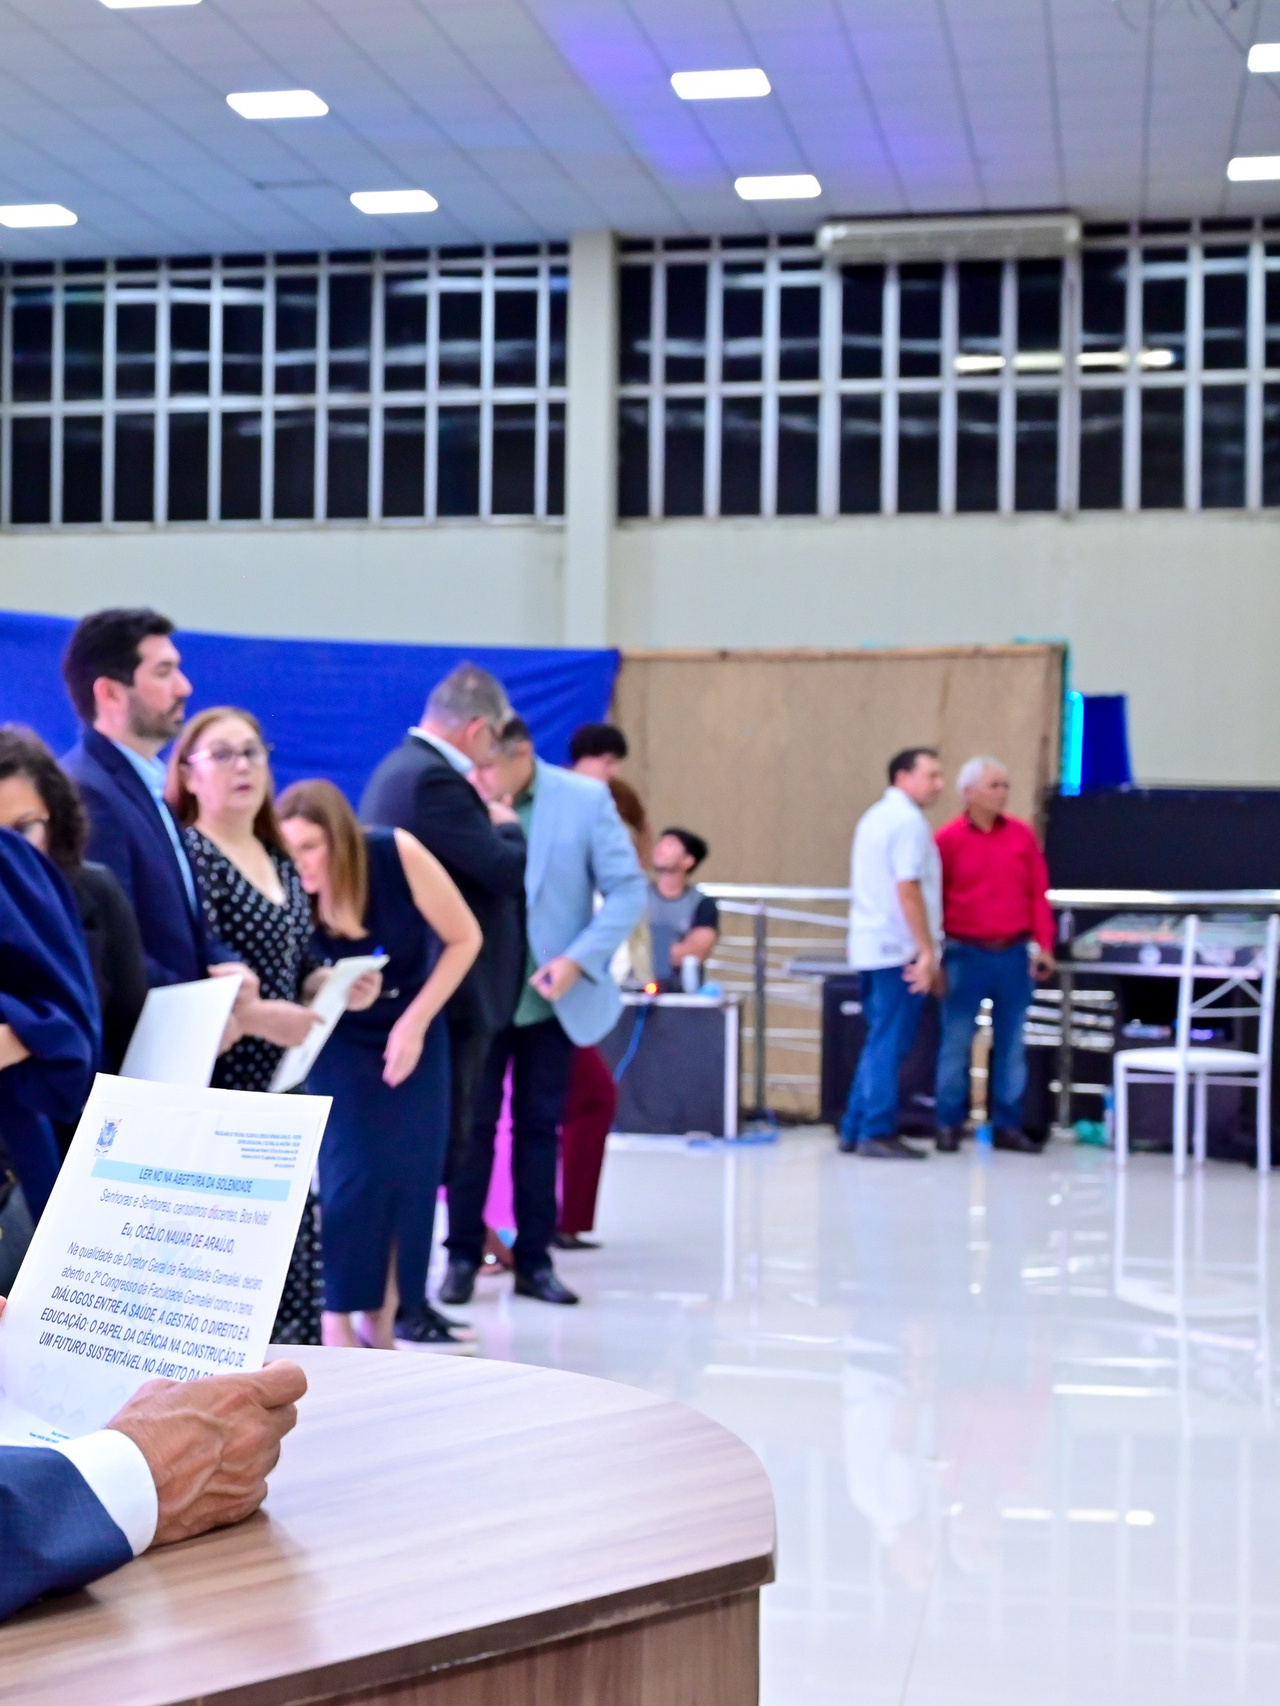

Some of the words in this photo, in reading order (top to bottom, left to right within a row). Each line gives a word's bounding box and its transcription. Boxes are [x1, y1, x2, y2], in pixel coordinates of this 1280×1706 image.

[139, 1168, 153, 1180] LER
[154, 1170, 163, 1182] NO
[164, 1171, 173, 1183] NA
[172, 1173, 205, 1188] ABERTURA
[205, 1176, 215, 1189] DA
[215, 1178, 253, 1193] SOLENIDADE
[100, 1188, 133, 1207] Senhoras
[133, 1197, 139, 1208] e
[239, 1208, 253, 1224] Boa
[121, 1221, 134, 1239] Eu,
[135, 1223, 165, 1242] OCÉLIO
[164, 1229, 192, 1247] NAUAR
[191, 1233, 204, 1248] DE
[203, 1234, 235, 1256] ARAÚJO,
[67, 1241, 79, 1256] Na
[79, 1246, 113, 1263] qualidade
[113, 1250, 123, 1265] de
[123, 1253, 148, 1270] Diretor
[148, 1258, 168, 1274] Geral
[166, 1261, 176, 1276] da
[176, 1262, 212, 1282] Faculdade
[61, 1265, 84, 1281] aberto
[84, 1272, 90, 1283] o
[100, 1272, 138, 1293] Congresso
[138, 1281, 148, 1296] da
[148, 1282, 183, 1303] Faculdade
[183, 1289, 215, 1308] Gamaliel
[214, 1298, 233, 1313] como
[232, 1302, 238, 1313] o
[51, 1284, 95, 1308] DIÁLOGOS
[93, 1296, 123, 1314] ENTRE
[120, 1302, 129, 1316] A
[128, 1302, 158, 1324] SAÚDE,
[157, 1310, 166, 1324] A
[165, 1312, 199, 1334] GESTÃO,
[200, 1318, 209, 1333] O
[207, 1320, 239, 1340] DIREITO
[238, 1325, 245, 1341] E
[243, 1327, 250, 1342] A
[39, 1331, 54, 1347] UM
[52, 1335, 87, 1355] FUTURO
[86, 1343, 141, 1370] SUSTENTÁVEL
[141, 1357, 156, 1373] NO
[155, 1358, 188, 1381] ÂMBITO
[187, 1368, 200, 1382] DA
[40, 1307, 89, 1331] EDUCAÇÃO:
[89, 1319, 97, 1333] O
[96, 1321, 123, 1340] PAPEL
[123, 1328, 137, 1342] DA
[136, 1329, 168, 1350] CIÊNCIA
[168, 1338, 181, 1353] NA
[181, 1340, 235, 1367] CONSTRUÇÃO
[235, 1352, 246, 1368] DE
